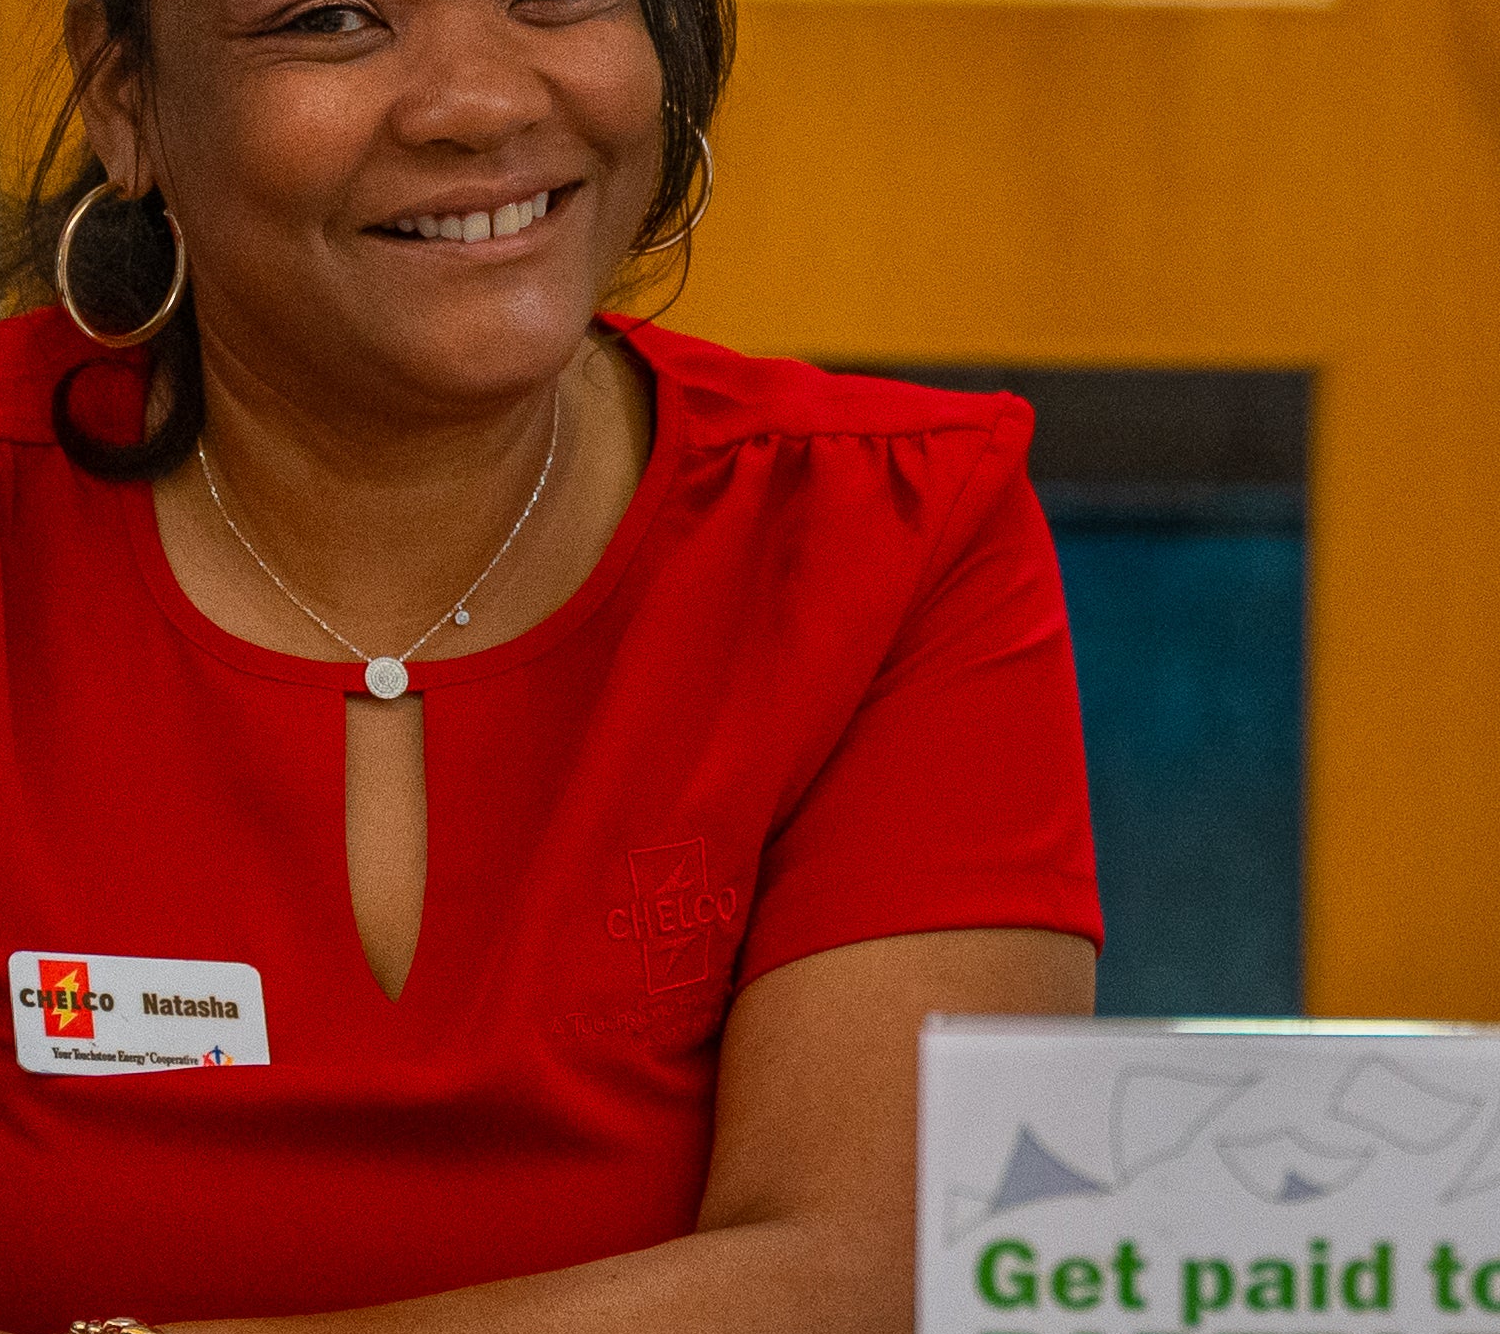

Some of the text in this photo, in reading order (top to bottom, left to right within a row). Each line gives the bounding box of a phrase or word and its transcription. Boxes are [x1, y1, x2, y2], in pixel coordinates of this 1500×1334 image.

[19, 988, 239, 1019] CHELCO Natasha
[52, 1047, 72, 1060] Your
[73, 1048, 116, 1062] Touchstone
[150, 1053, 198, 1066] Cooperative
[975, 1237, 1145, 1314] Get
[1181, 1237, 1393, 1325] paid
